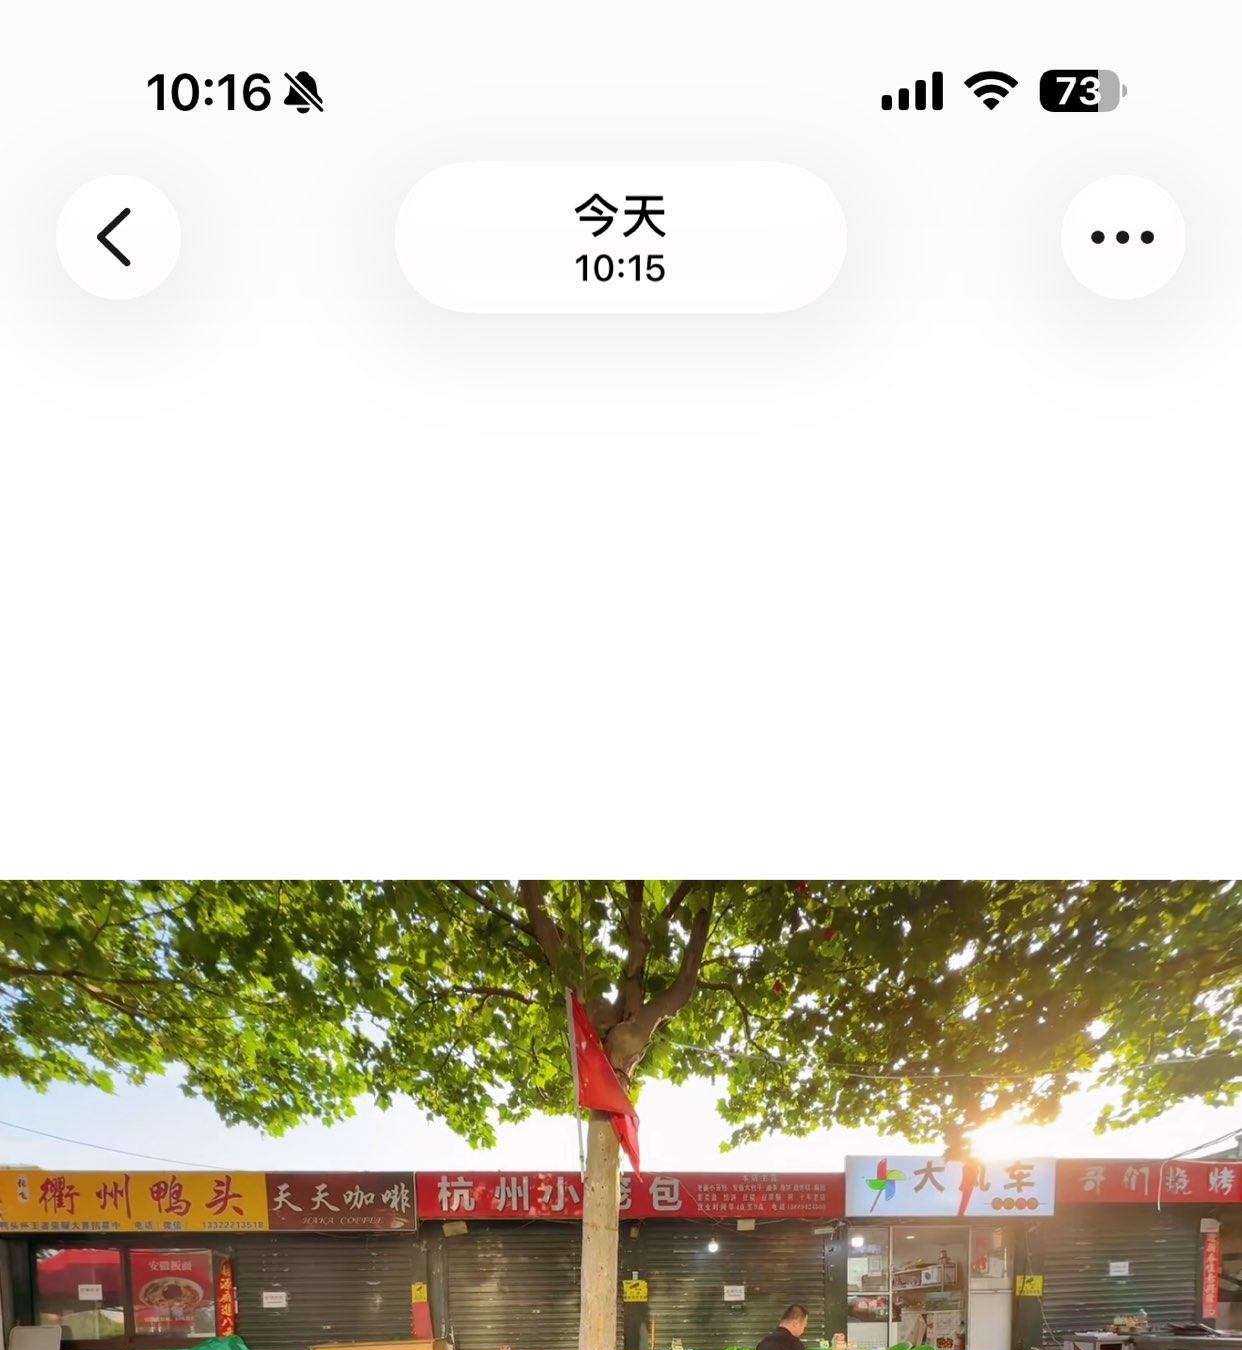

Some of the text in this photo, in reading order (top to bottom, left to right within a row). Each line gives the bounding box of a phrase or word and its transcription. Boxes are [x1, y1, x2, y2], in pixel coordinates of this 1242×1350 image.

[147, 72, 272, 112] 10:16
[1056, 76, 1101, 106] 73
[574, 193, 666, 238] 今天
[575, 253, 666, 283] 10:15
[39, 1173, 244, 1219] 衢州鸭头
[273, 1183, 410, 1213] 天天咖啡
